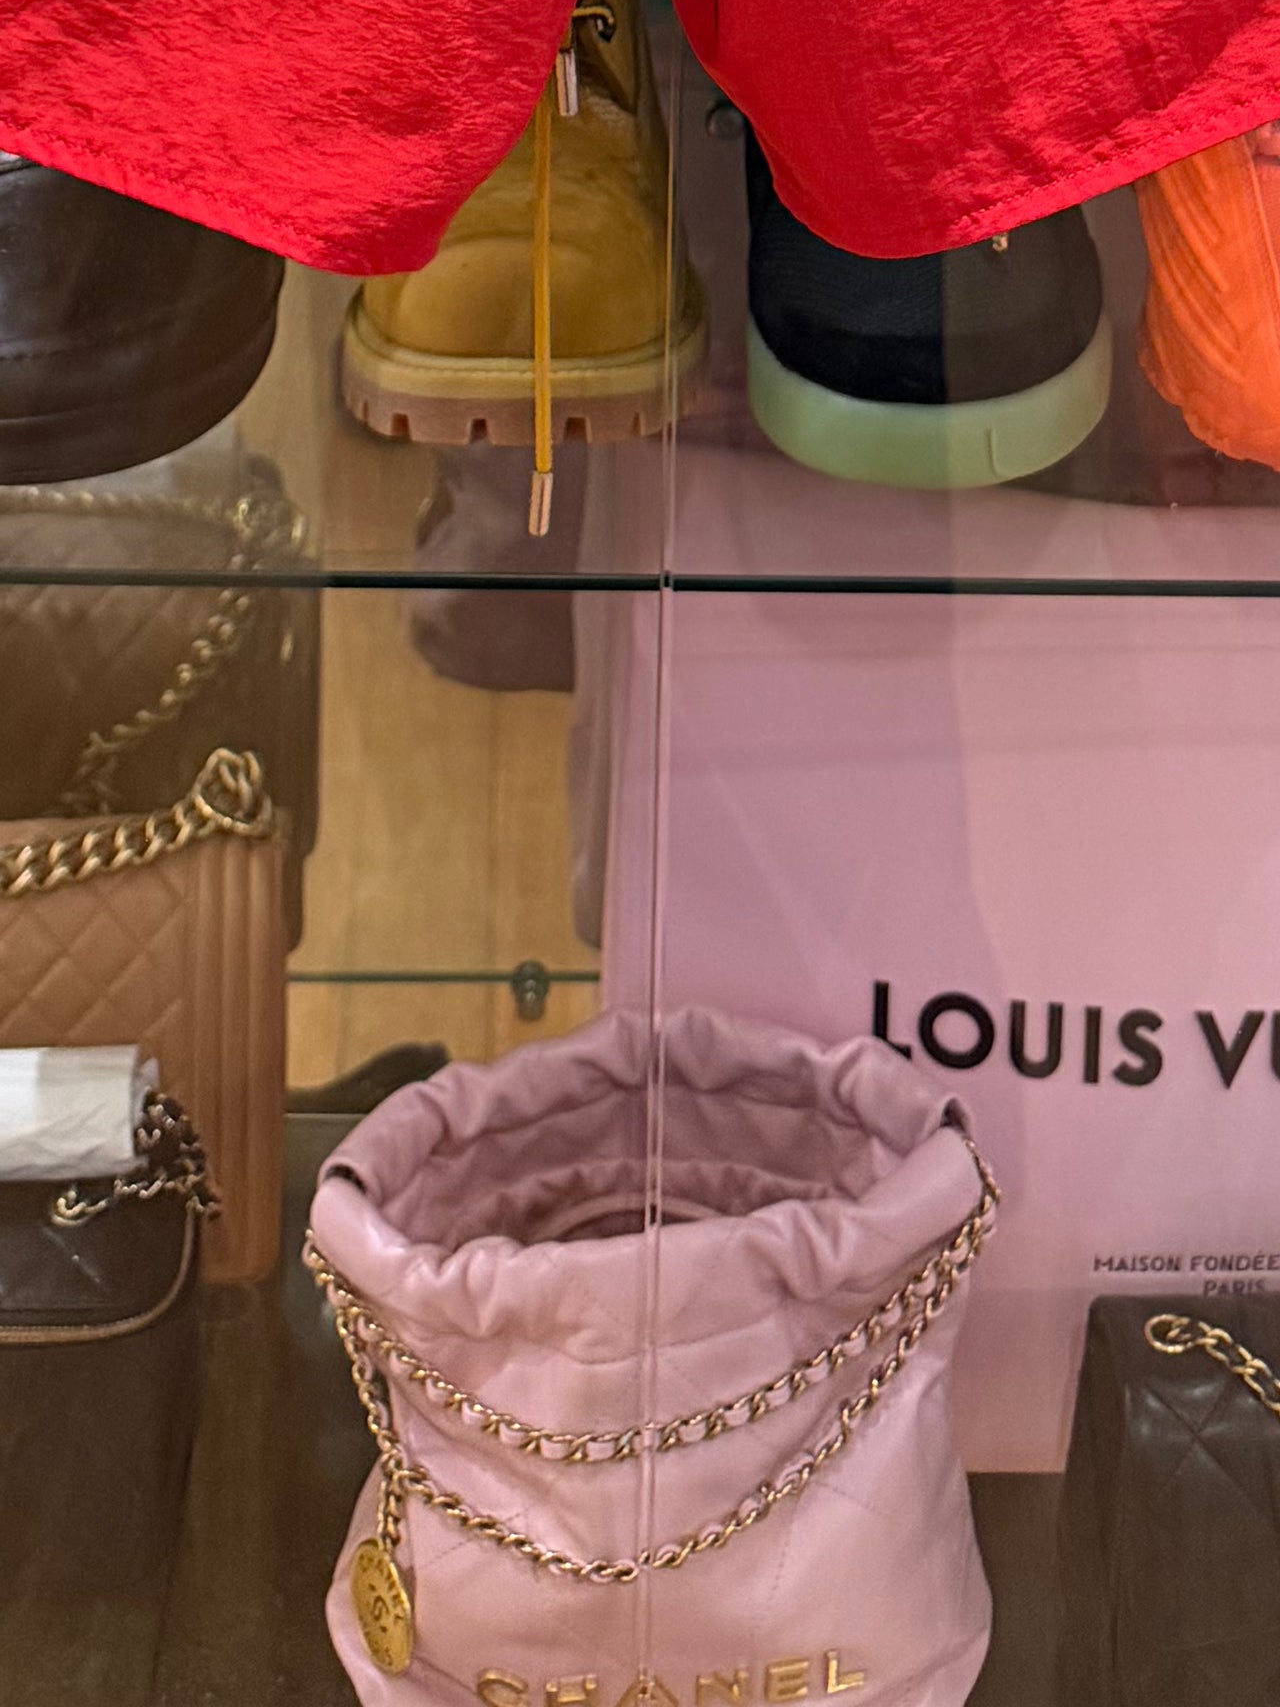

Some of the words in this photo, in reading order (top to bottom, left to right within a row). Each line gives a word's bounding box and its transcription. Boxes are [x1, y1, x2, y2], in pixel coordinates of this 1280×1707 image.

[872, 980, 1164, 1087] LOUIS
[1093, 1256, 1181, 1272] MAISON
[1203, 1279, 1268, 1297] PARIS
[476, 1649, 866, 1707] CHANEL
